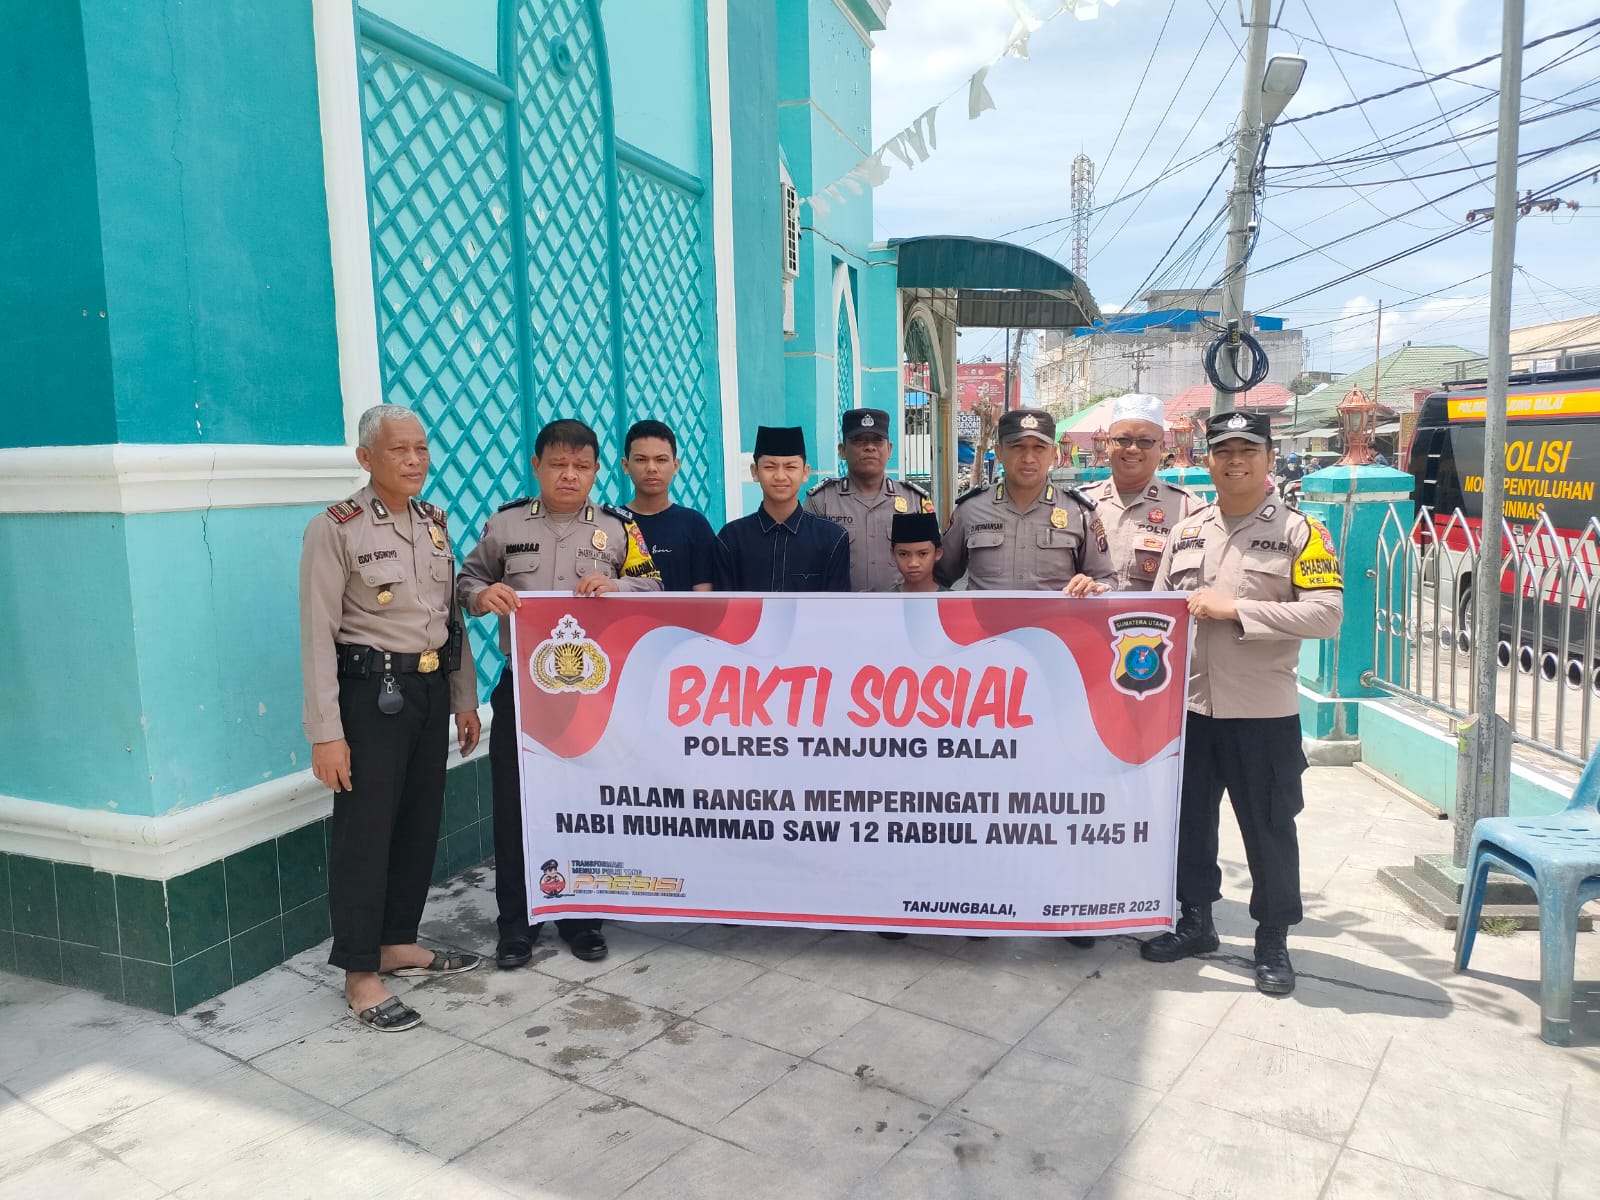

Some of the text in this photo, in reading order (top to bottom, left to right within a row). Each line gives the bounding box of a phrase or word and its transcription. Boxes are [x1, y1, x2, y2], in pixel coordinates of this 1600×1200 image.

[1504, 440, 1573, 473] OLISI
[1504, 477, 1595, 501] PENYULUHAN
[1502, 500, 1545, 520] INMAS
[1251, 540, 1290, 552] POLRI
[668, 665, 1034, 729] BAKTI SOSIAL
[684, 736, 1017, 759] POLRES TANJUNG BALAI
[600, 785, 1106, 815] DALAM RANGKA MEMPERINGATI MAULID
[556, 813, 1149, 845] NABI MUHAMMAD SAW 12 RABIUL AWAL 1445 H
[575, 874, 685, 893] PRESISI
[902, 900, 1161, 918] TANJUNGBALAI, SEPTEMBER 2023
